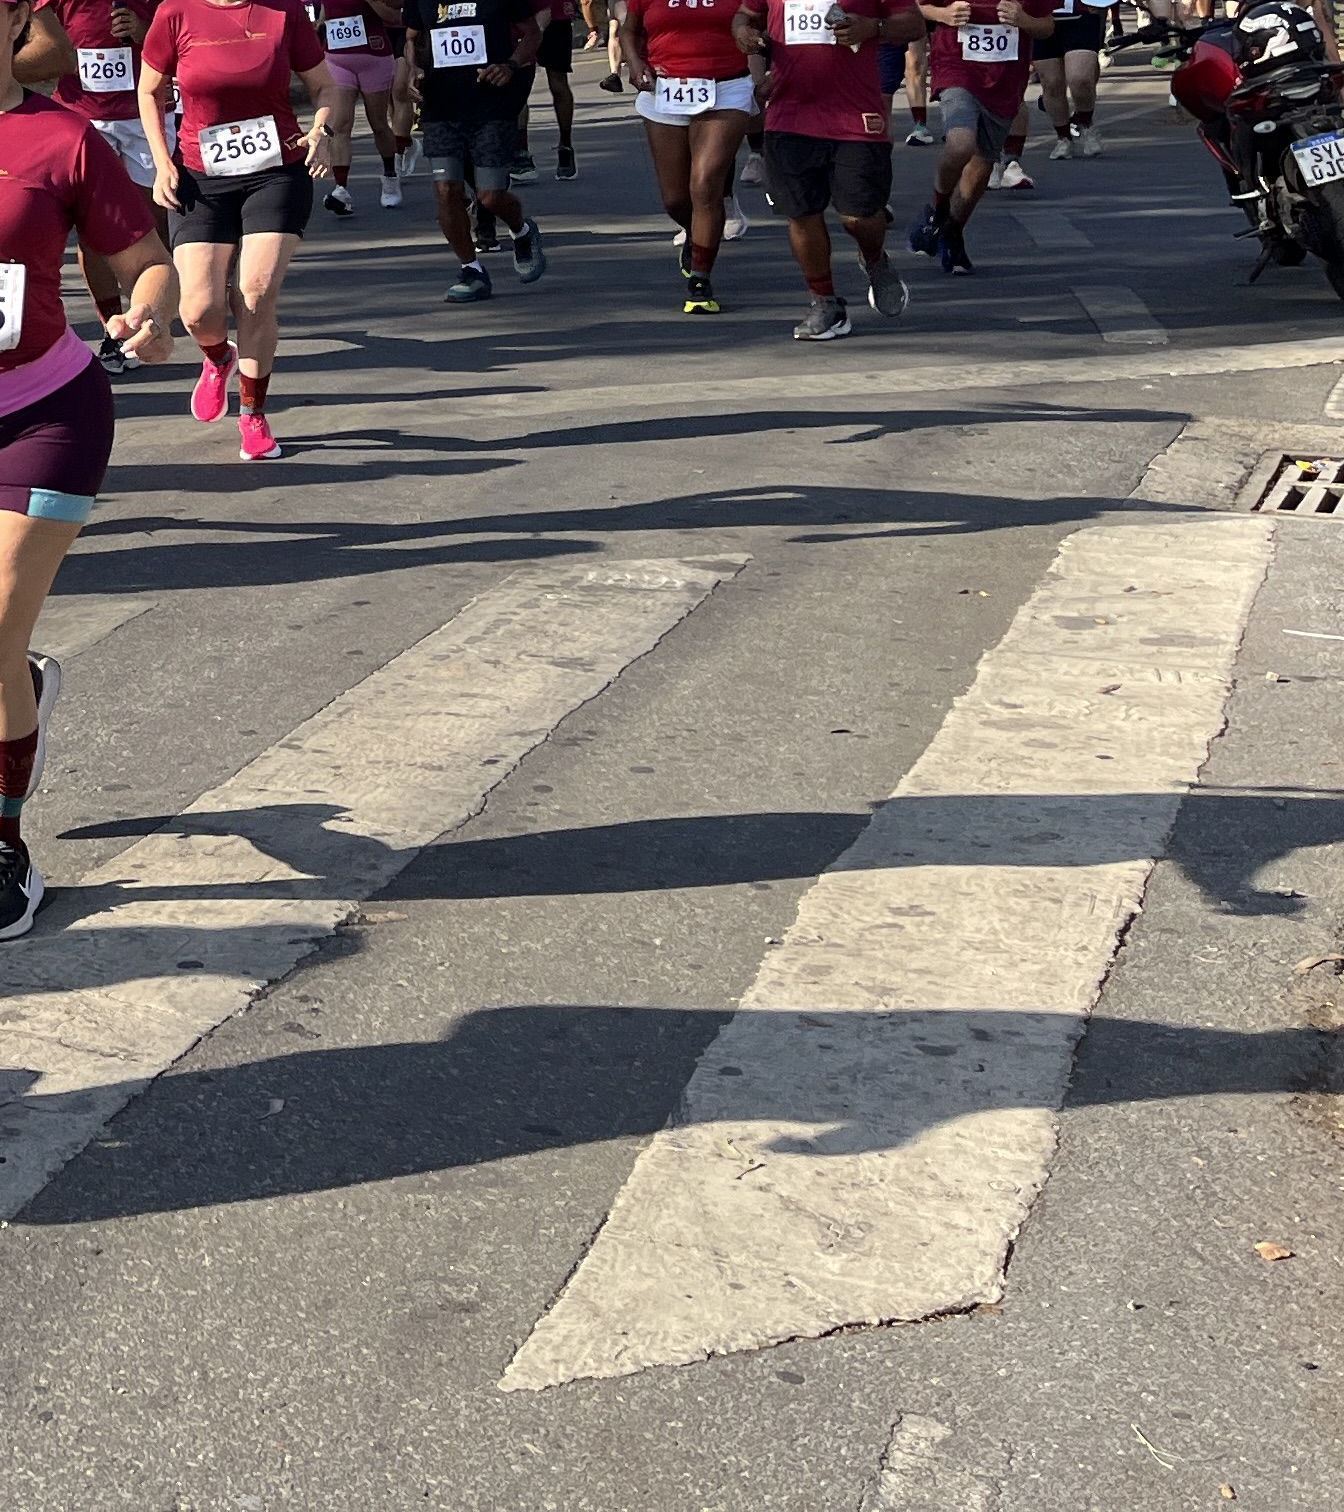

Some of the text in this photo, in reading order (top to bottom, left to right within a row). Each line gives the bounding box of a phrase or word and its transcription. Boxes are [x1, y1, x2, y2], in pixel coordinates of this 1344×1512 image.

[787, 14, 831, 31] 189
[330, 26, 361, 40] 1696
[440, 38, 475, 56] 100
[968, 35, 1008, 51] 830
[81, 61, 126, 79] 1269
[663, 88, 709, 103] 1413
[210, 131, 272, 163] 2563
